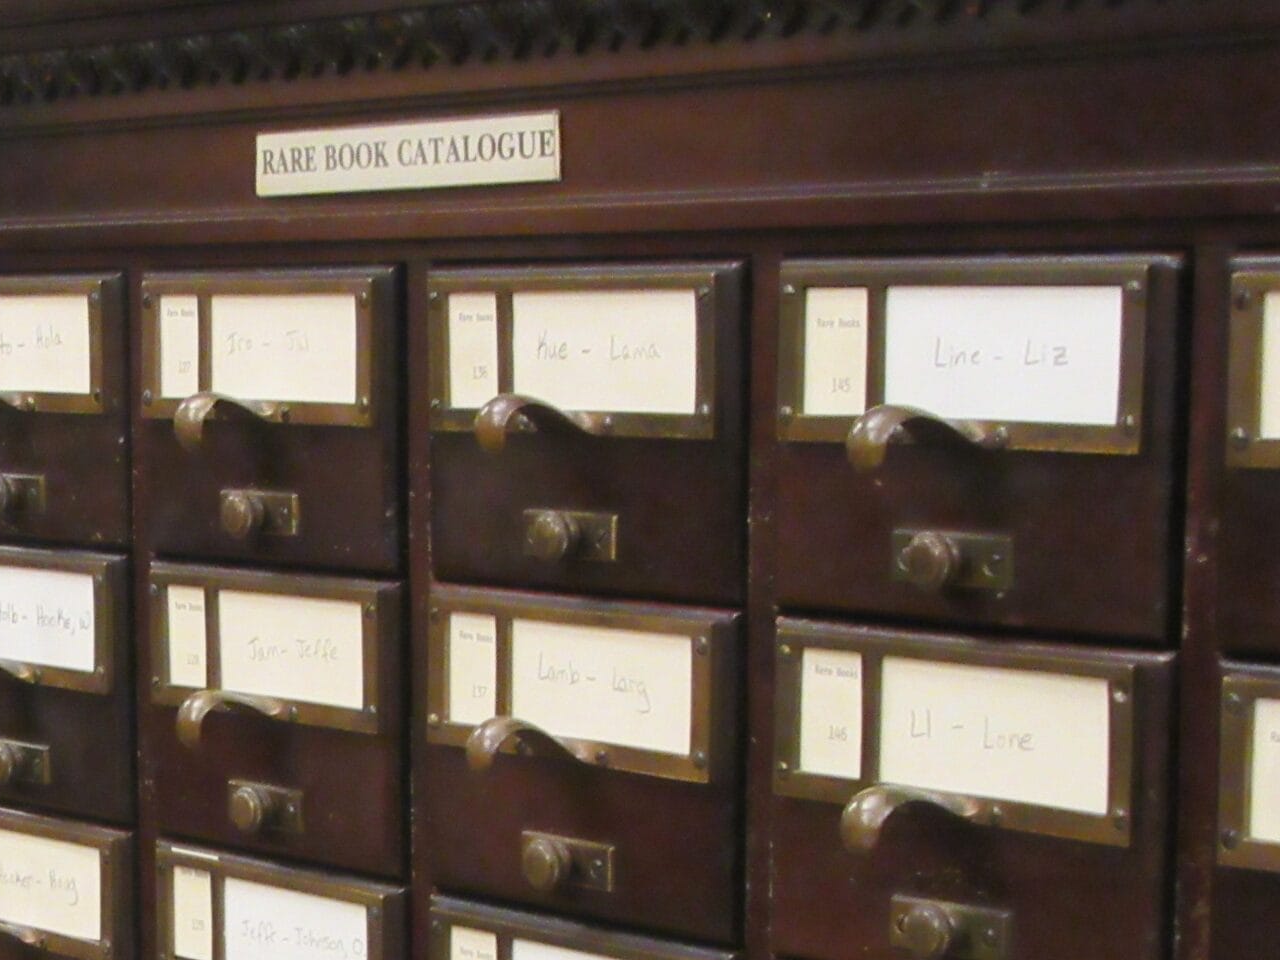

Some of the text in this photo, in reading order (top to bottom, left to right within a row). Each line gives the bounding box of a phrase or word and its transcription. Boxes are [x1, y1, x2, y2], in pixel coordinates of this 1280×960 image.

[261, 128, 555, 175] RARE BOOK CATALOGUE
[609, 334, 662, 362] Lama
[933, 335, 981, 369] Line
[1023, 336, 1071, 368] Liz
[830, 376, 852, 395] 145
[538, 650, 581, 686] Lamb
[612, 665, 652, 715] Larg
[826, 724, 850, 743] 146
[983, 715, 1037, 752] Lone
